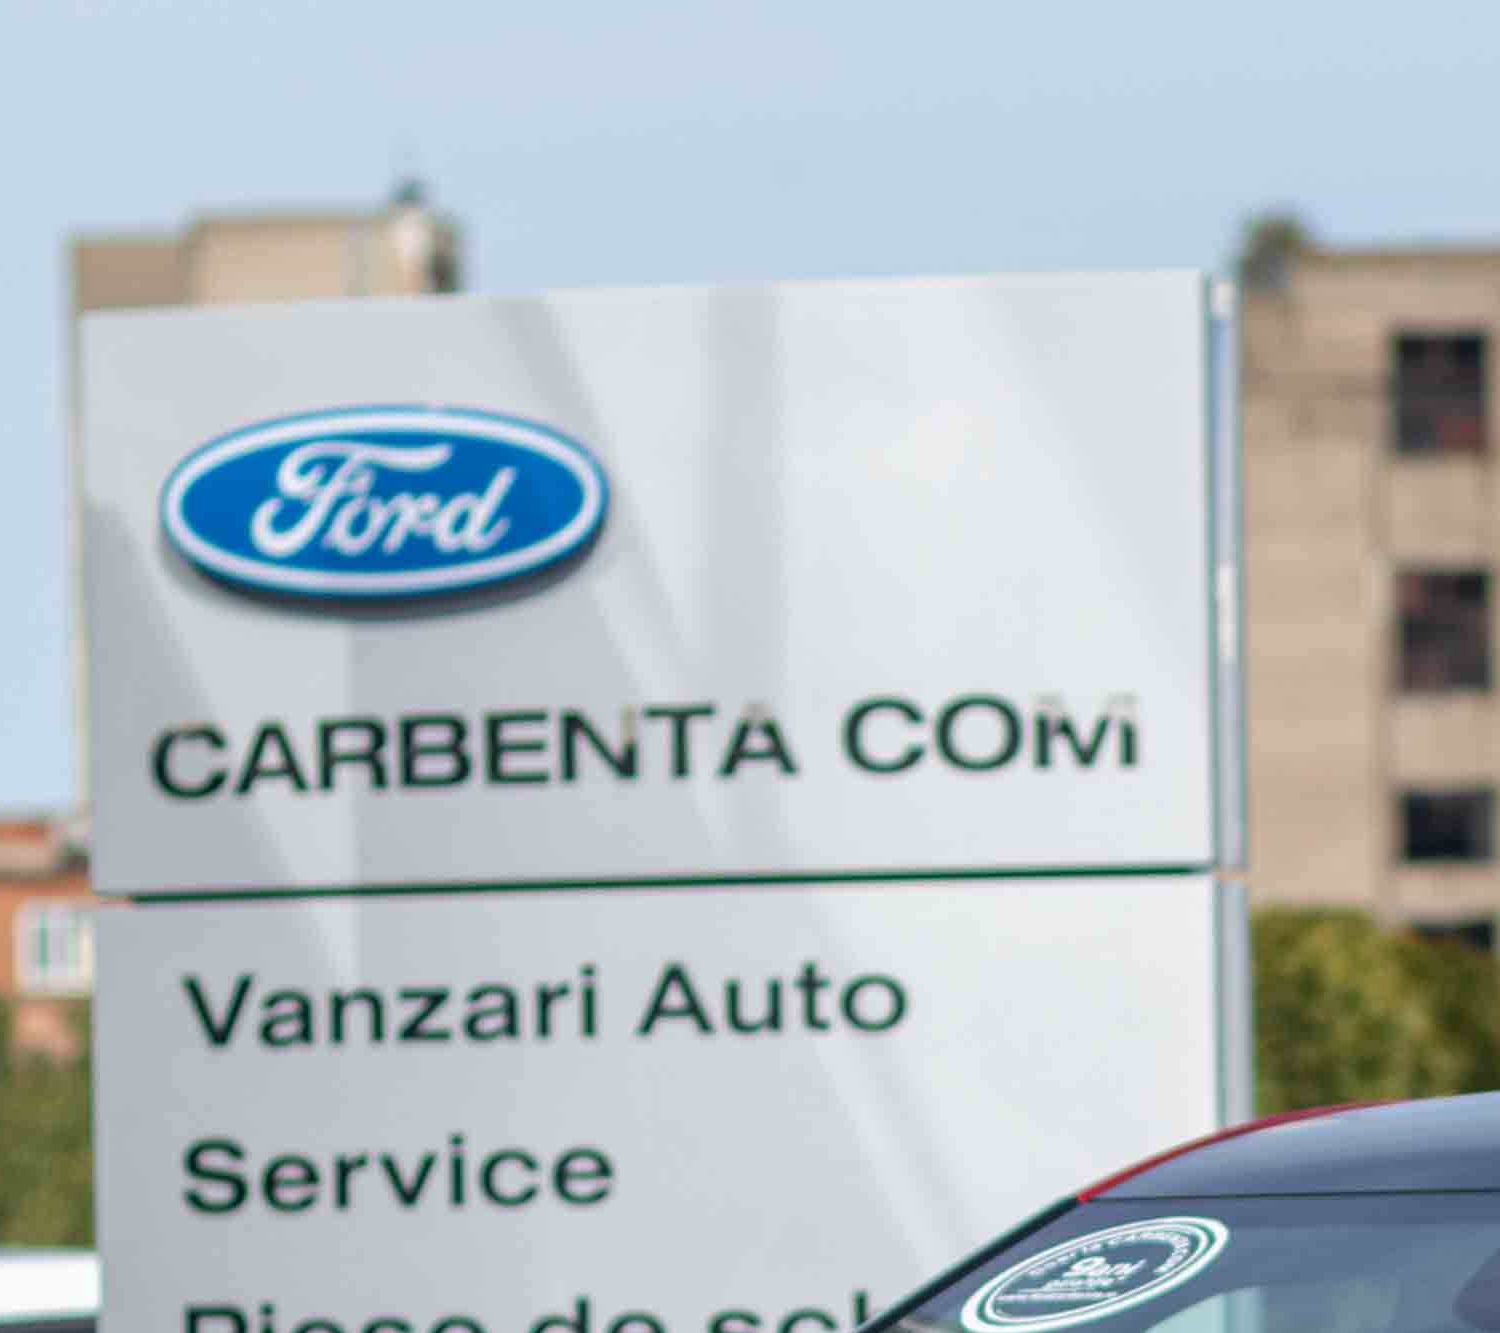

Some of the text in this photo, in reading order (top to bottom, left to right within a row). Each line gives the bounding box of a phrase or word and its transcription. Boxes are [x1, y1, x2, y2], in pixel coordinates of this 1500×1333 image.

[251, 441, 516, 557] Ford
[150, 694, 1140, 800] CARBENTA COM
[181, 961, 910, 1049] Vanzari Auto
[182, 1133, 615, 1215] Service
